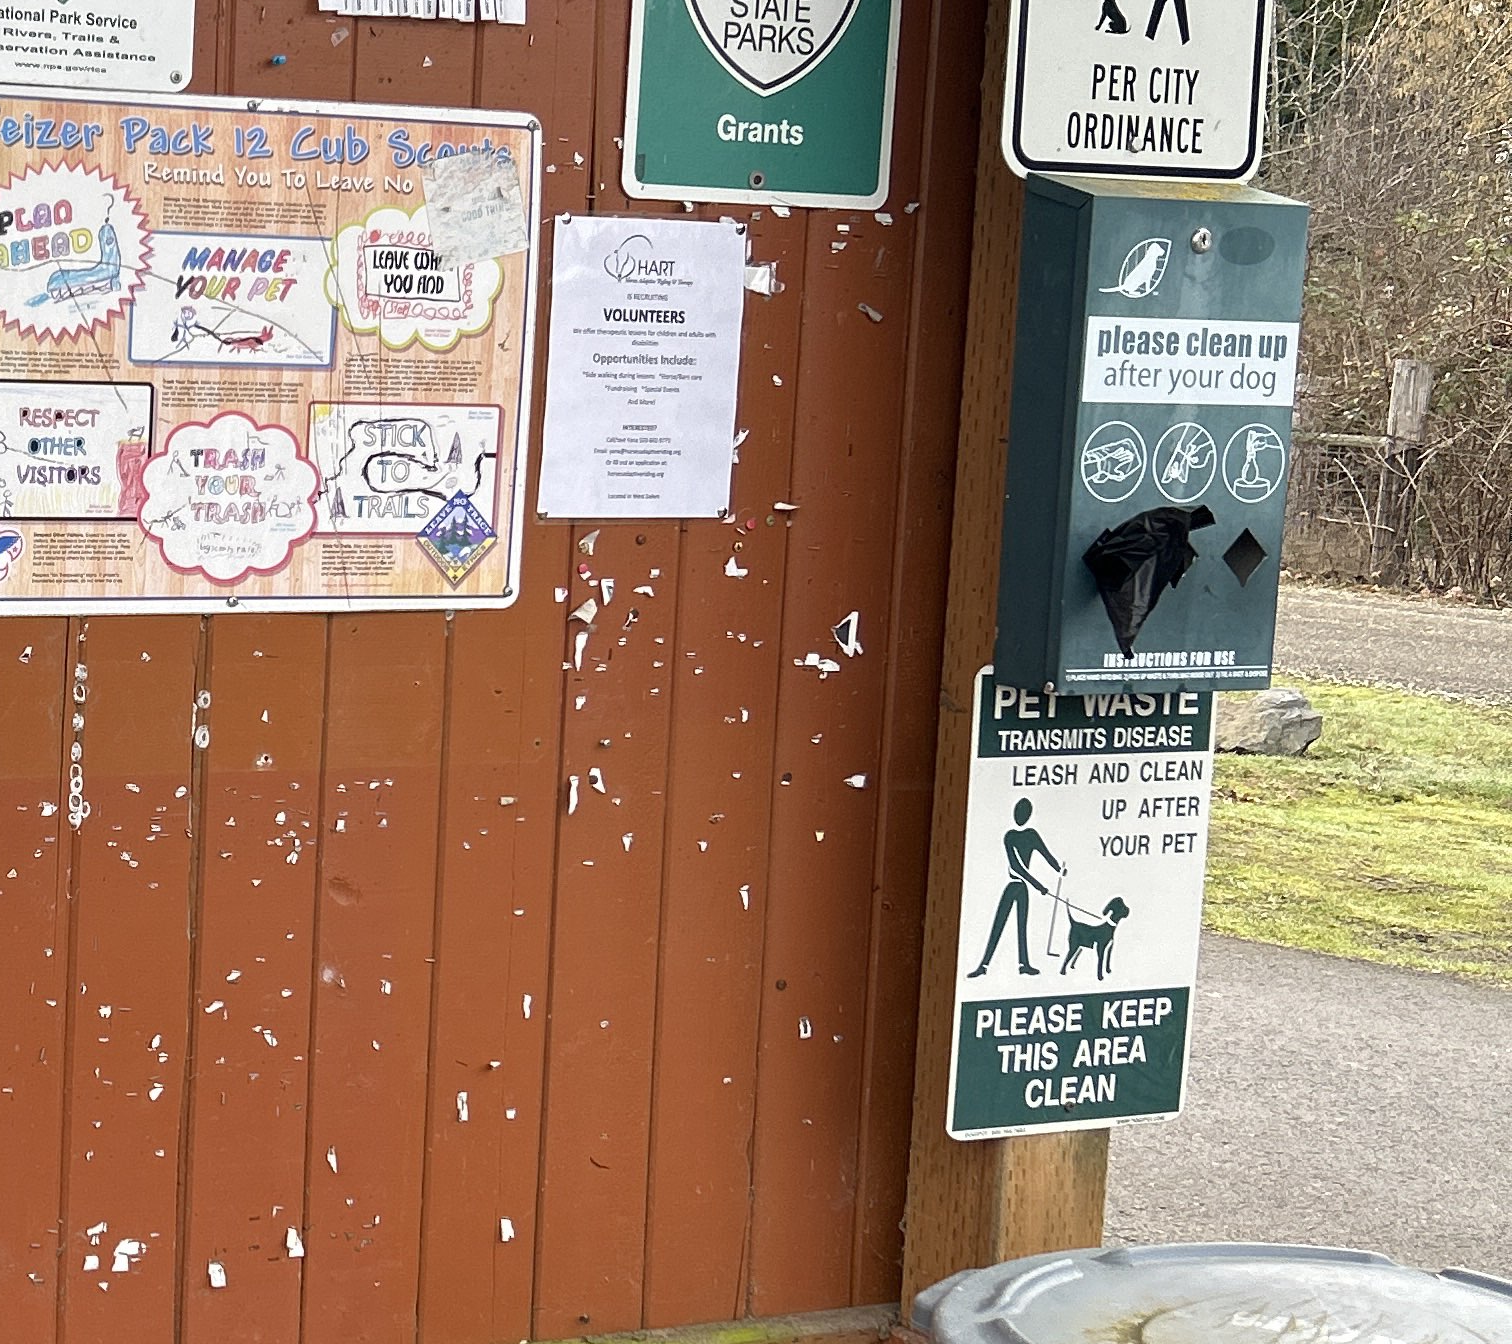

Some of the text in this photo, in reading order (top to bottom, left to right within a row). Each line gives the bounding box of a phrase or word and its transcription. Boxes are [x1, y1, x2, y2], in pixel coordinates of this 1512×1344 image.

[50, 9, 81, 25] Park
[86, 12, 137, 29] Service
[62, 32, 103, 42] Trails
[109, 35, 119, 44] &
[723, 22, 815, 56] PARKS
[73, 48, 155, 61] Assistance
[1092, 64, 1199, 104] PER CITY
[120, 117, 214, 154] Pack
[234, 126, 273, 157] 12
[291, 124, 369, 164] Cub
[717, 114, 803, 144] Grants
[1067, 111, 1203, 153] ORDINANCE
[144, 162, 414, 194] Remind You To Leave No
[182, 247, 291, 272] MANAGE
[373, 250, 409, 270] LEAVE
[638, 260, 675, 276] HART
[175, 275, 298, 302] YOUR PET
[384, 274, 444, 294] YOU FIND
[603, 308, 684, 323] VOLUNTEERS
[1097, 325, 1287, 361] please clean up
[593, 353, 658, 365] Opportunities
[1104, 359, 1275, 397] after your dog
[19, 407, 100, 428] RESPECT
[28, 436, 86, 456] OTHER
[363, 424, 426, 447] STICK
[190, 448, 266, 471] TRASH
[17, 465, 101, 486] VISITORS
[377, 460, 410, 483] TO
[195, 474, 261, 497] YOUR
[191, 502, 266, 524] TRASH
[353, 495, 430, 518] TRAILS
[424, 498, 492, 536] LEAVE NO TRACE
[1190, 652, 1211, 666] FOR
[1214, 651, 1236, 666] USE
[994, 684, 1198, 720] PET WASTE
[998, 725, 1192, 751] TRANSMITS DISEASE
[1013, 760, 1202, 786] LEASH AND CLEAN
[1102, 796, 1199, 819] UP AFTER
[1099, 832, 1197, 856] YOUR PET
[976, 997, 1172, 1037] PLEASE KEEP
[997, 1035, 1146, 1073] THIS AREA
[1025, 1073, 1115, 1108] CLEAN
